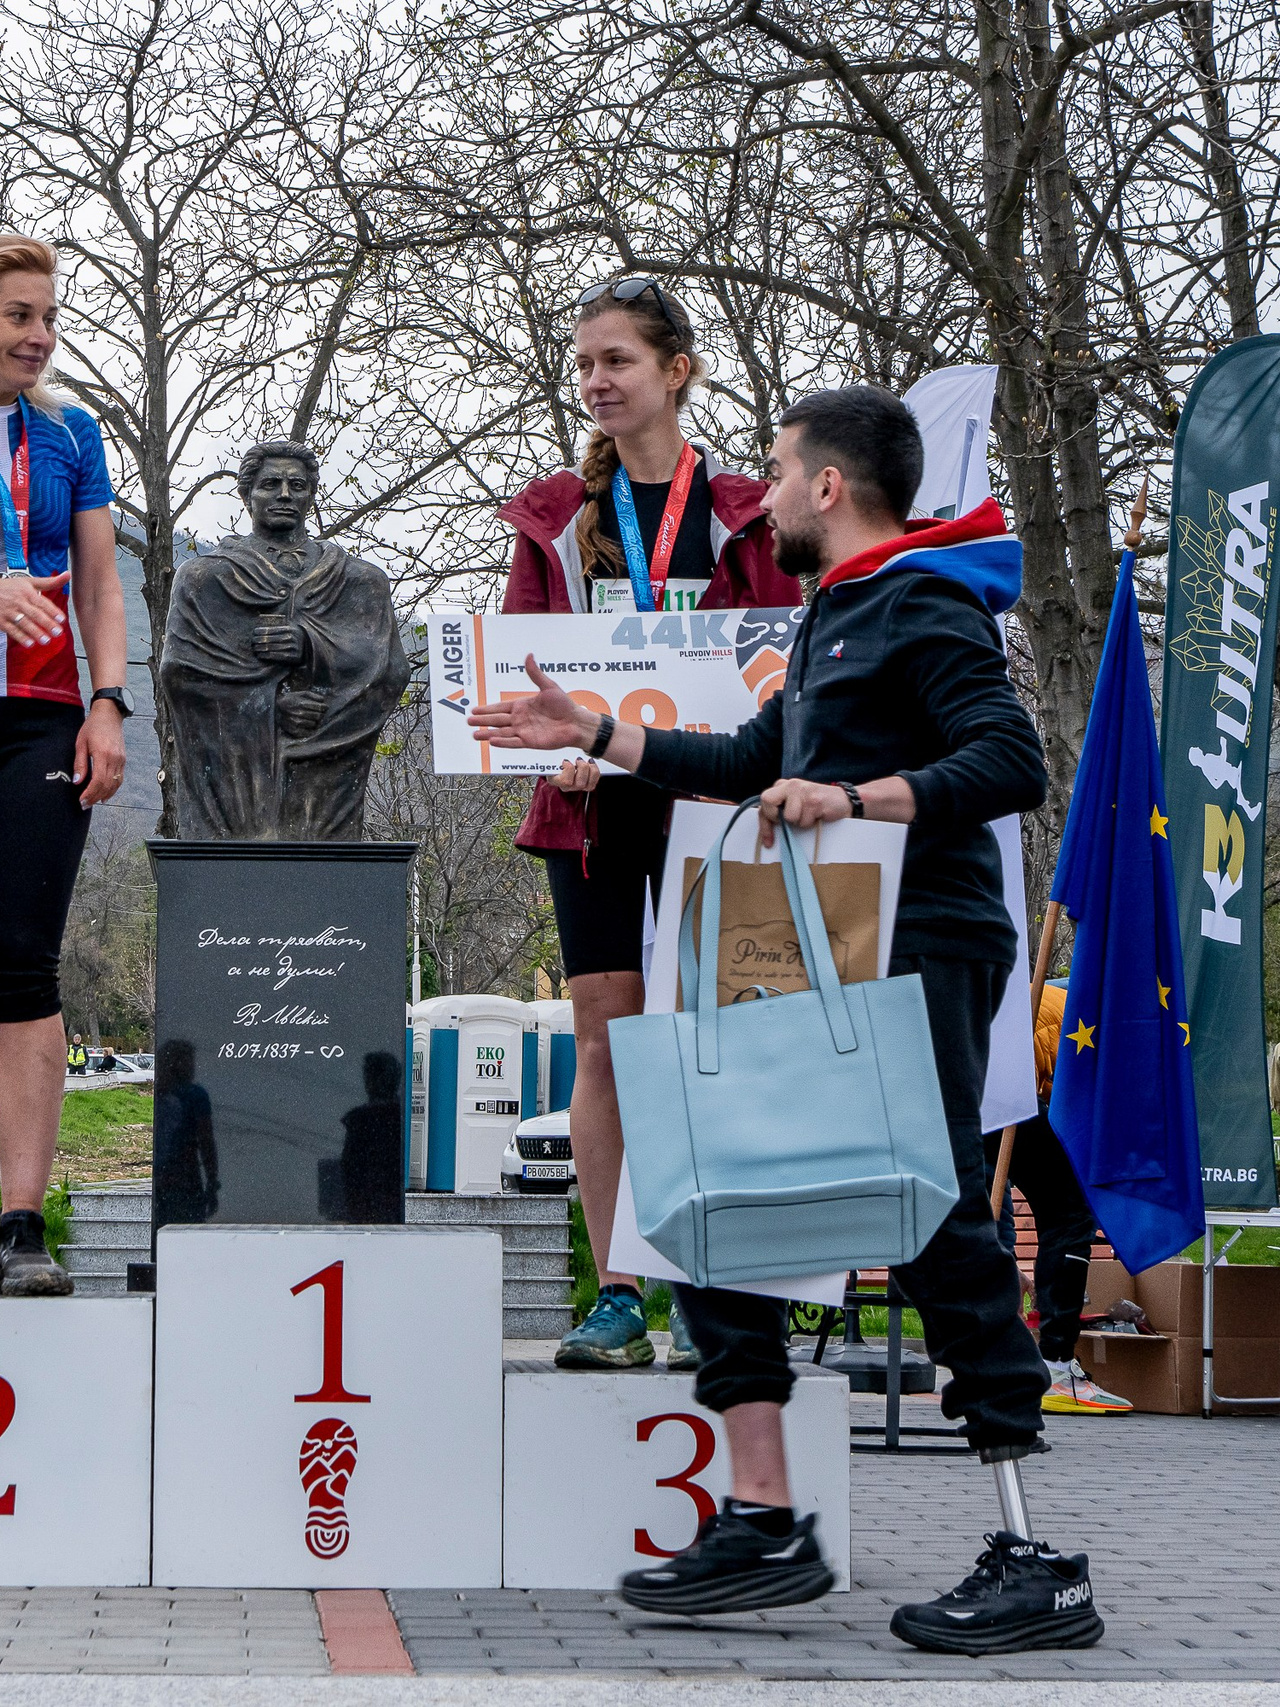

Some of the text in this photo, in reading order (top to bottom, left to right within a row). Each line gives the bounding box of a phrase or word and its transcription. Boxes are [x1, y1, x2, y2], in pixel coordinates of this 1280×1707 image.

[1268, 506, 1278, 553] RACE
[611, 613, 733, 650] 44K
[442, 622, 464, 686] AIGER
[679, 650, 711, 658] PLOVDIV
[539, 661, 602, 673] МЯСТО
[604, 661, 657, 672] ЖЕНИ
[501, 763, 564, 773] www.aiger.c
[197, 927, 251, 948] Дела
[731, 938, 782, 965] Pirin
[227, 955, 346, 991] а не думи!
[217, 1042, 301, 1059] 18.07.1837
[476, 1046, 505, 1061] EKO
[1201, 1166, 1258, 1183] TRA.BG
[290, 1260, 372, 1403] 1
[633, 1413, 718, 1559] 3
[1010, 1545, 1035, 1557] OKA
[1054, 1581, 1092, 1611] HOKA
